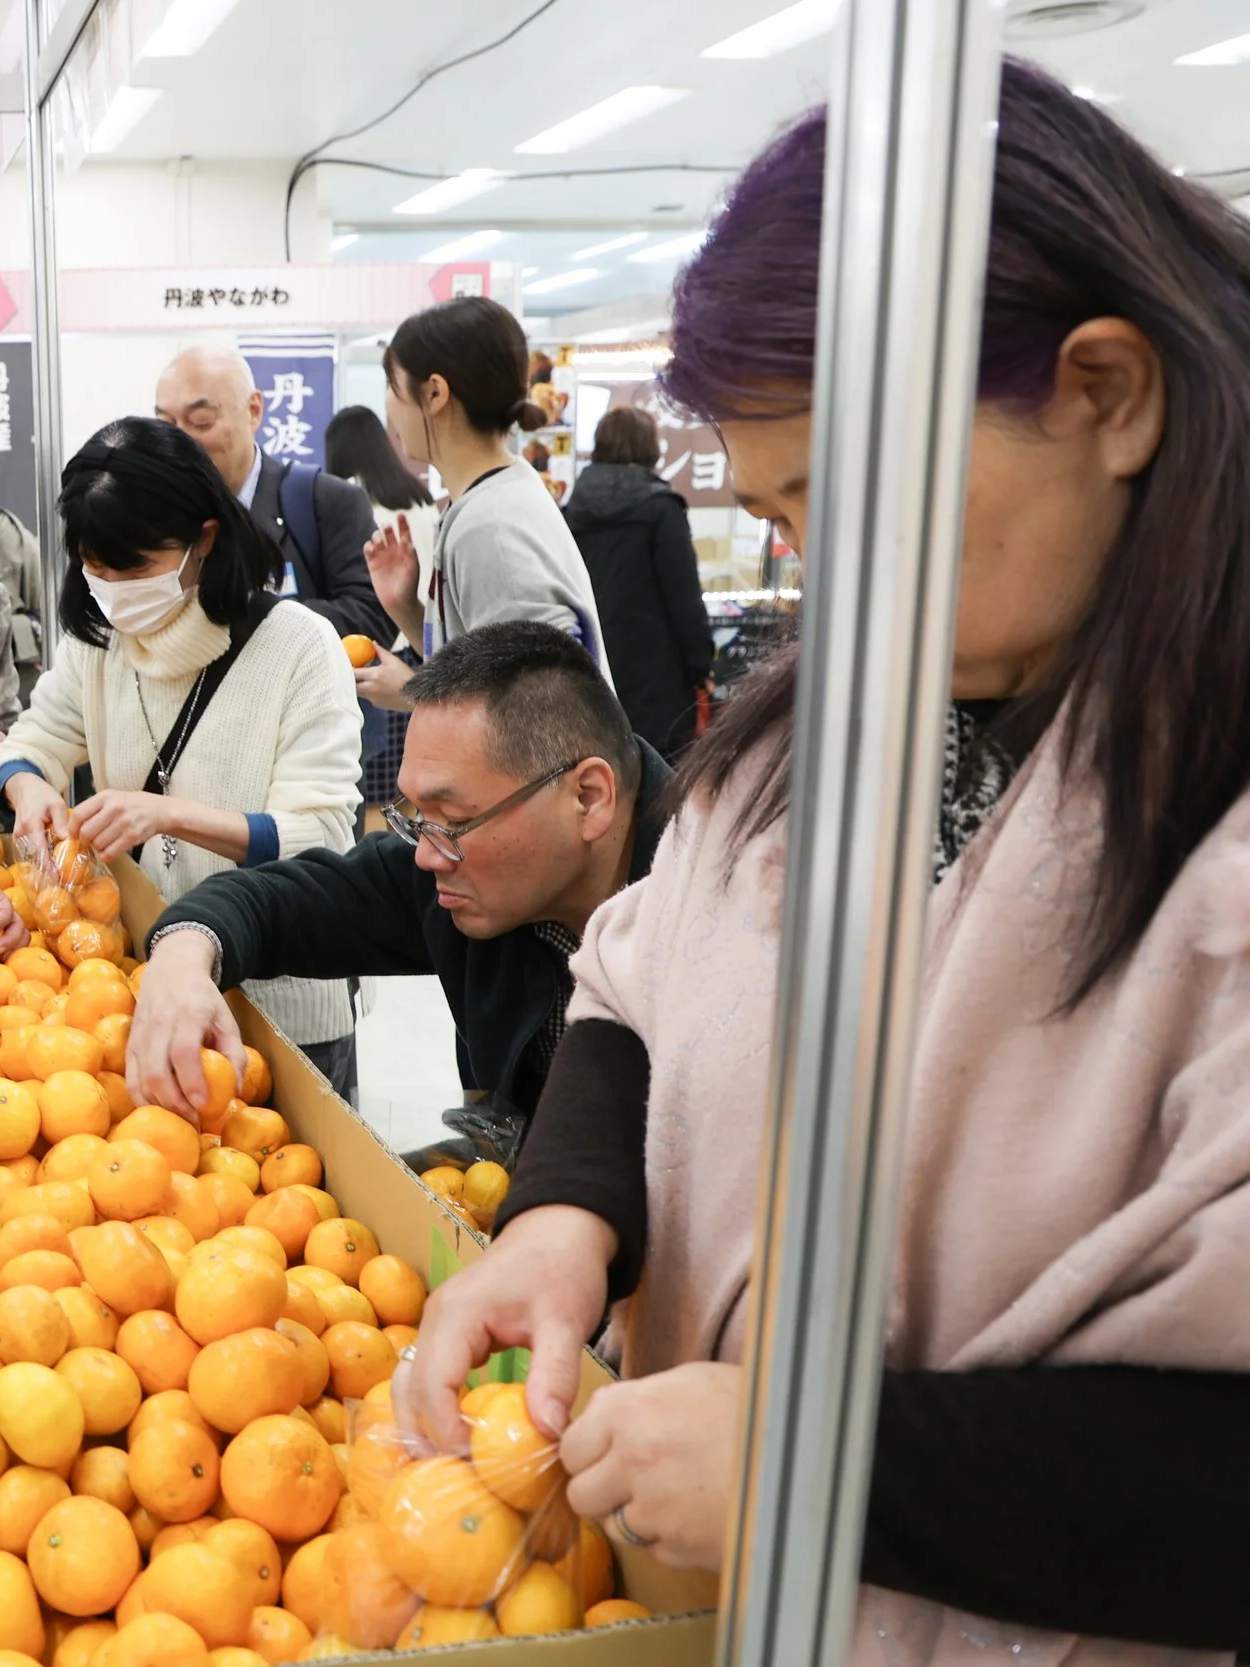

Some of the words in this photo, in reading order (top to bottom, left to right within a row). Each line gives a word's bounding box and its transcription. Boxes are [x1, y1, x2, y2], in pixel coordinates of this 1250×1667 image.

[164, 286, 290, 309] 丹波やながわ
[261, 371, 314, 466] 丹波
